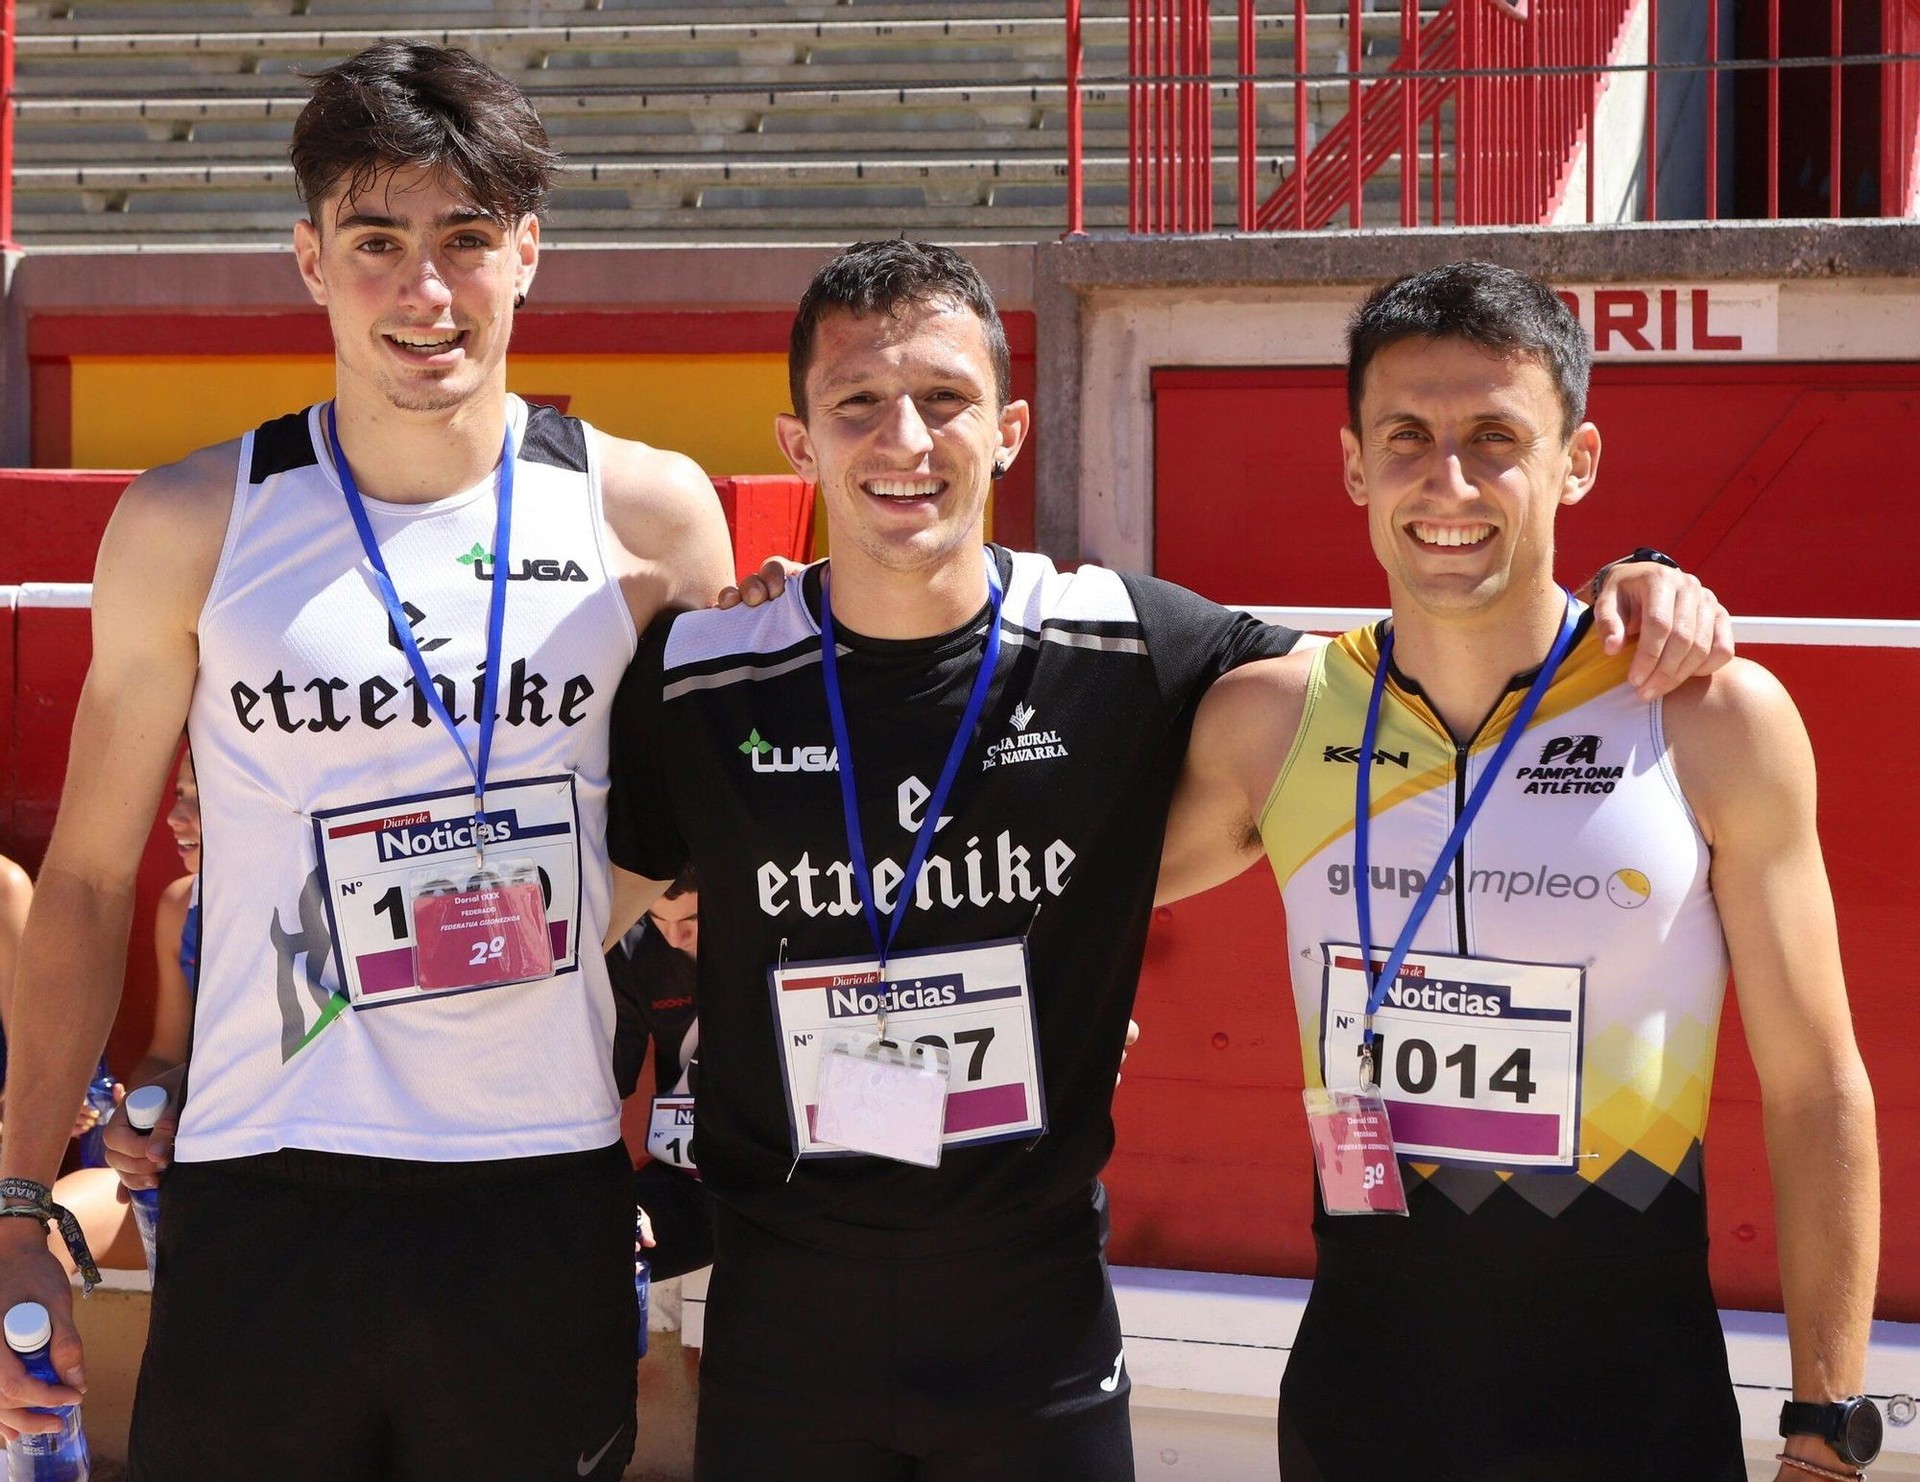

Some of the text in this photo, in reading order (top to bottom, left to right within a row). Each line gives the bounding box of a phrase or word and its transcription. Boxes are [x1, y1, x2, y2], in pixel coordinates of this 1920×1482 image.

[1557, 289, 1742, 351] RIL
[1017, 730, 1062, 748] RURAL
[1000, 744, 1068, 765] NAVARRA
[1539, 735, 1603, 766] PA
[1516, 766, 1625, 780] PAMPLONA
[1523, 779, 1617, 795] ATLÉTICO
[382, 813, 429, 830] Diario de
[381, 818, 512, 860] Noticias
[454, 894, 480, 904] Dorsal
[461, 906, 497, 917] FEDERADO
[440, 920, 478, 932] FEDERATUA
[832, 973, 876, 987] Diario de
[1410, 967, 1423, 977] de
[1357, 1033, 1537, 1104] 1014
